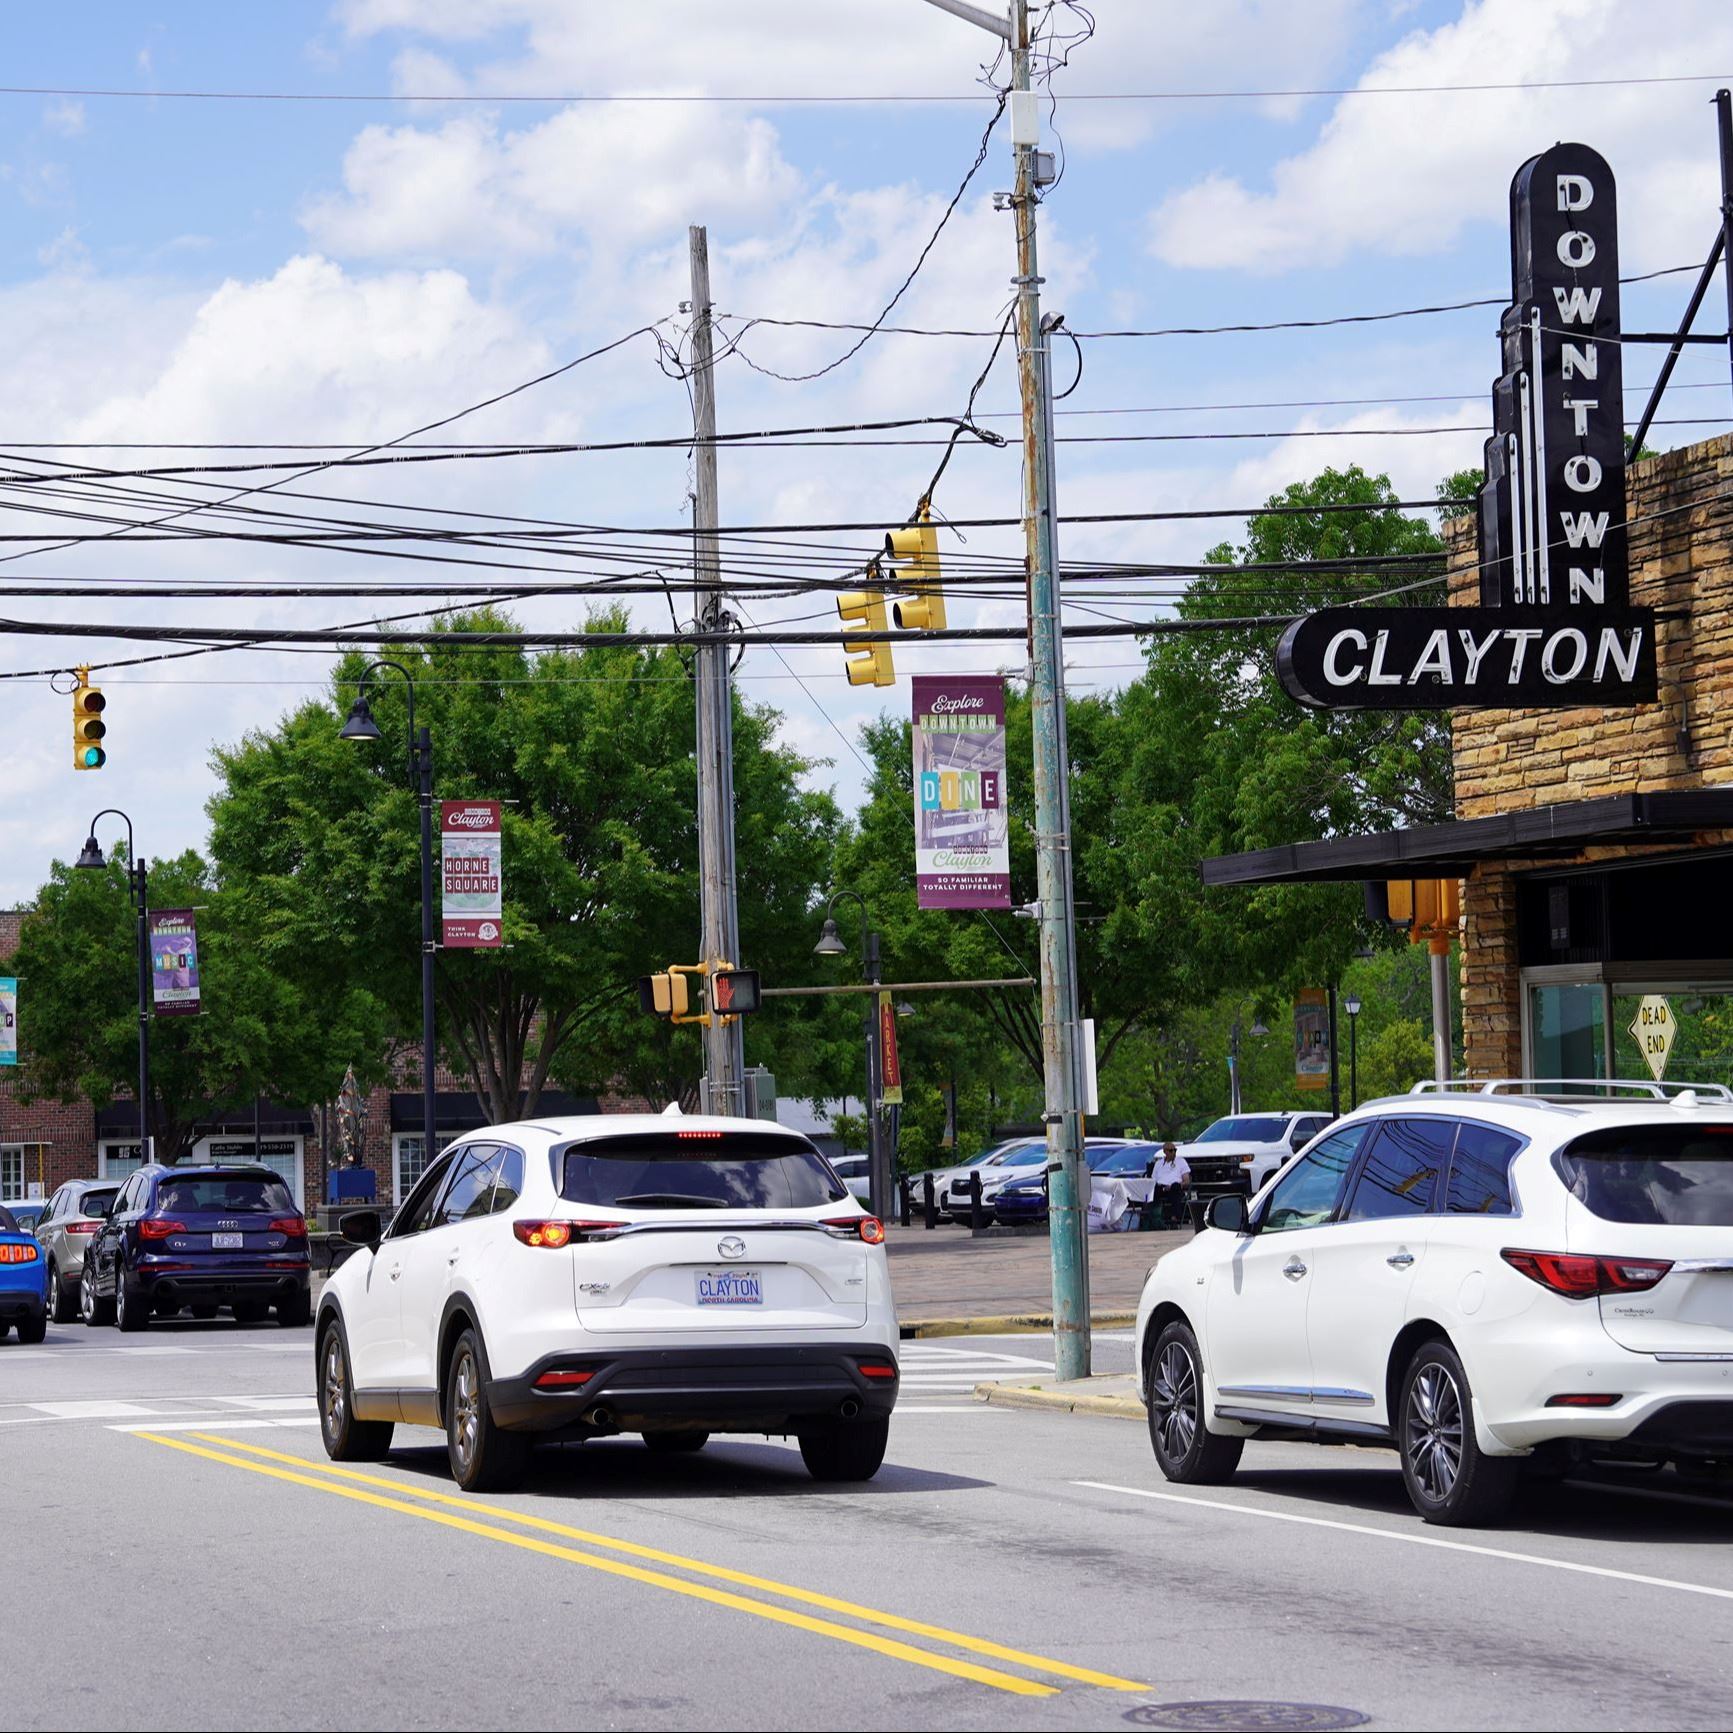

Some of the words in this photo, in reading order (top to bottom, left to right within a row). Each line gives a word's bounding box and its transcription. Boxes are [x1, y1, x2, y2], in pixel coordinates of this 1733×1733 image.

[1552, 173, 1610, 605] DOWNTOWN
[1322, 627, 1643, 687] CLAYTON
[931, 694, 985, 714] Explore
[920, 717, 996, 731] DOWNTOWN
[923, 778, 996, 802] DINE
[447, 811, 495, 828] Clayton
[446, 860, 488, 872] HORNE
[932, 850, 993, 870] Clayton
[446, 879, 498, 891] SQUARE
[155, 956, 193, 967] MUSIC
[1642, 1005, 1667, 1026] DEAD
[883, 1003, 894, 1085] MARKET
[1647, 1034, 1665, 1054] END
[699, 1279, 759, 1297] CLAYTON
[702, 1296, 726, 1304] NORTH
[727, 1296, 759, 1304] CAROLINA
